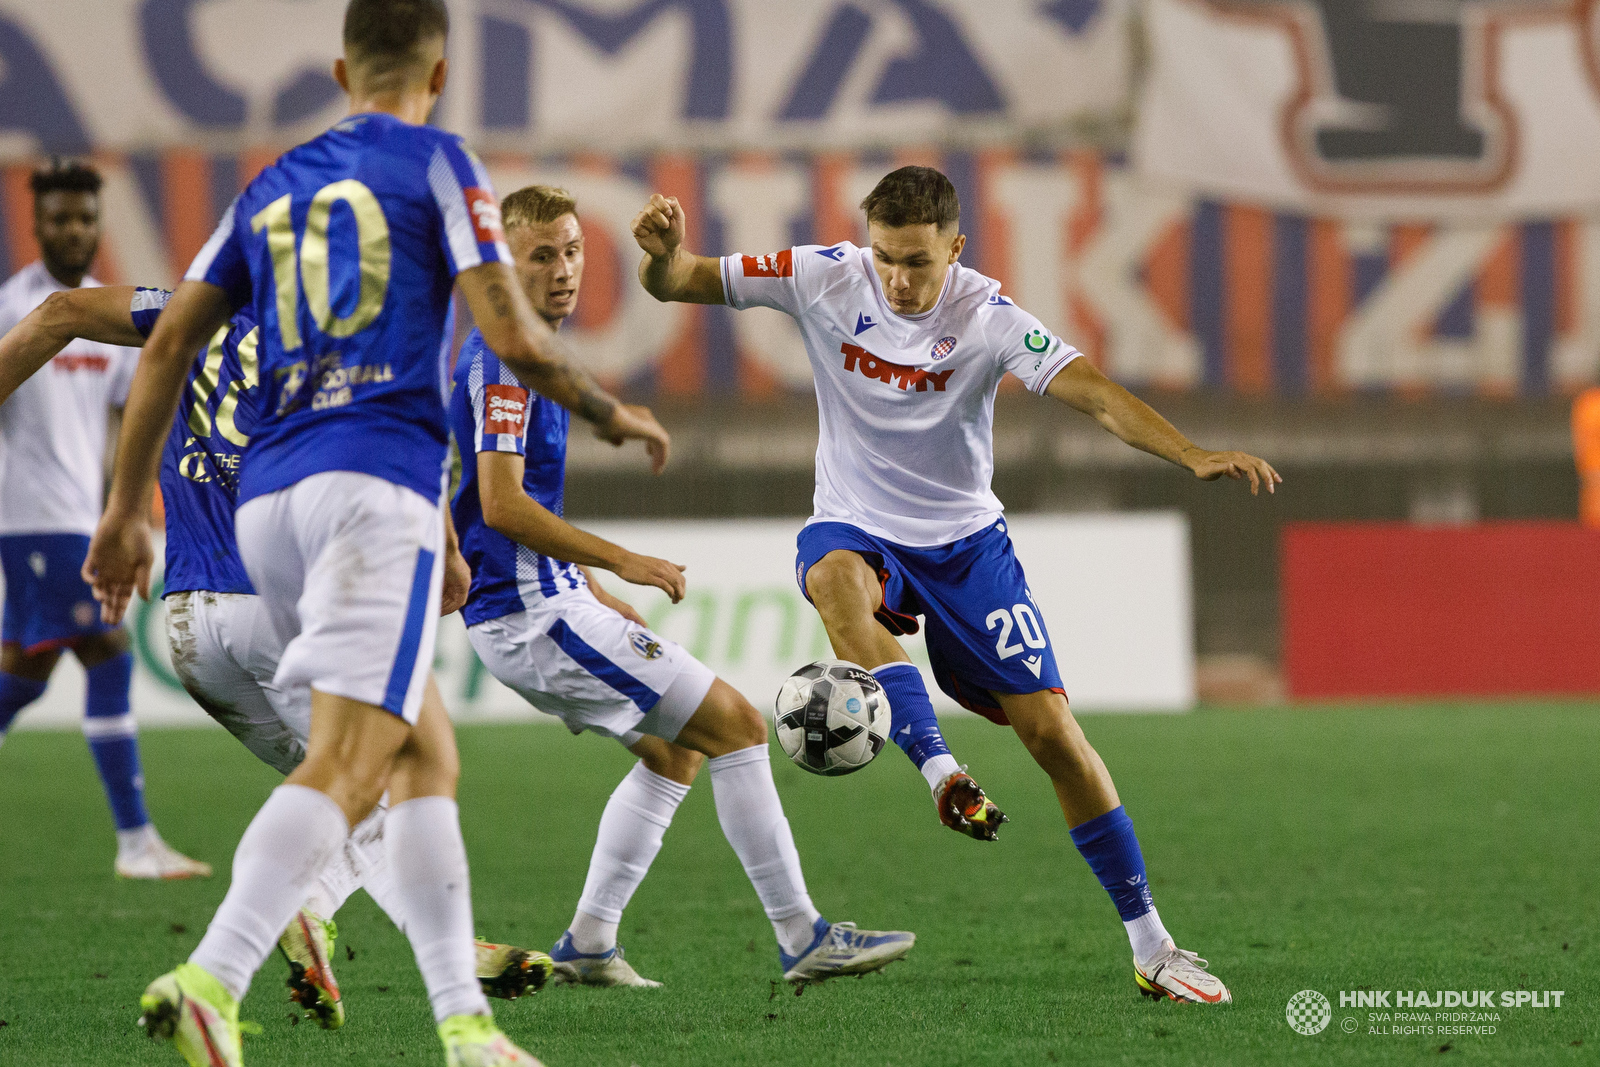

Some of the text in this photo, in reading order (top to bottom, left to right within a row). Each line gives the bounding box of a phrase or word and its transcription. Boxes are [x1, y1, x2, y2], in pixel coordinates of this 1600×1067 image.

[250, 178, 392, 352] 10
[840, 342, 956, 393] TOMMY
[489, 395, 525, 411] Super
[490, 408, 523, 424] Sport
[214, 452, 241, 469] THE
[985, 603, 1047, 661] 20
